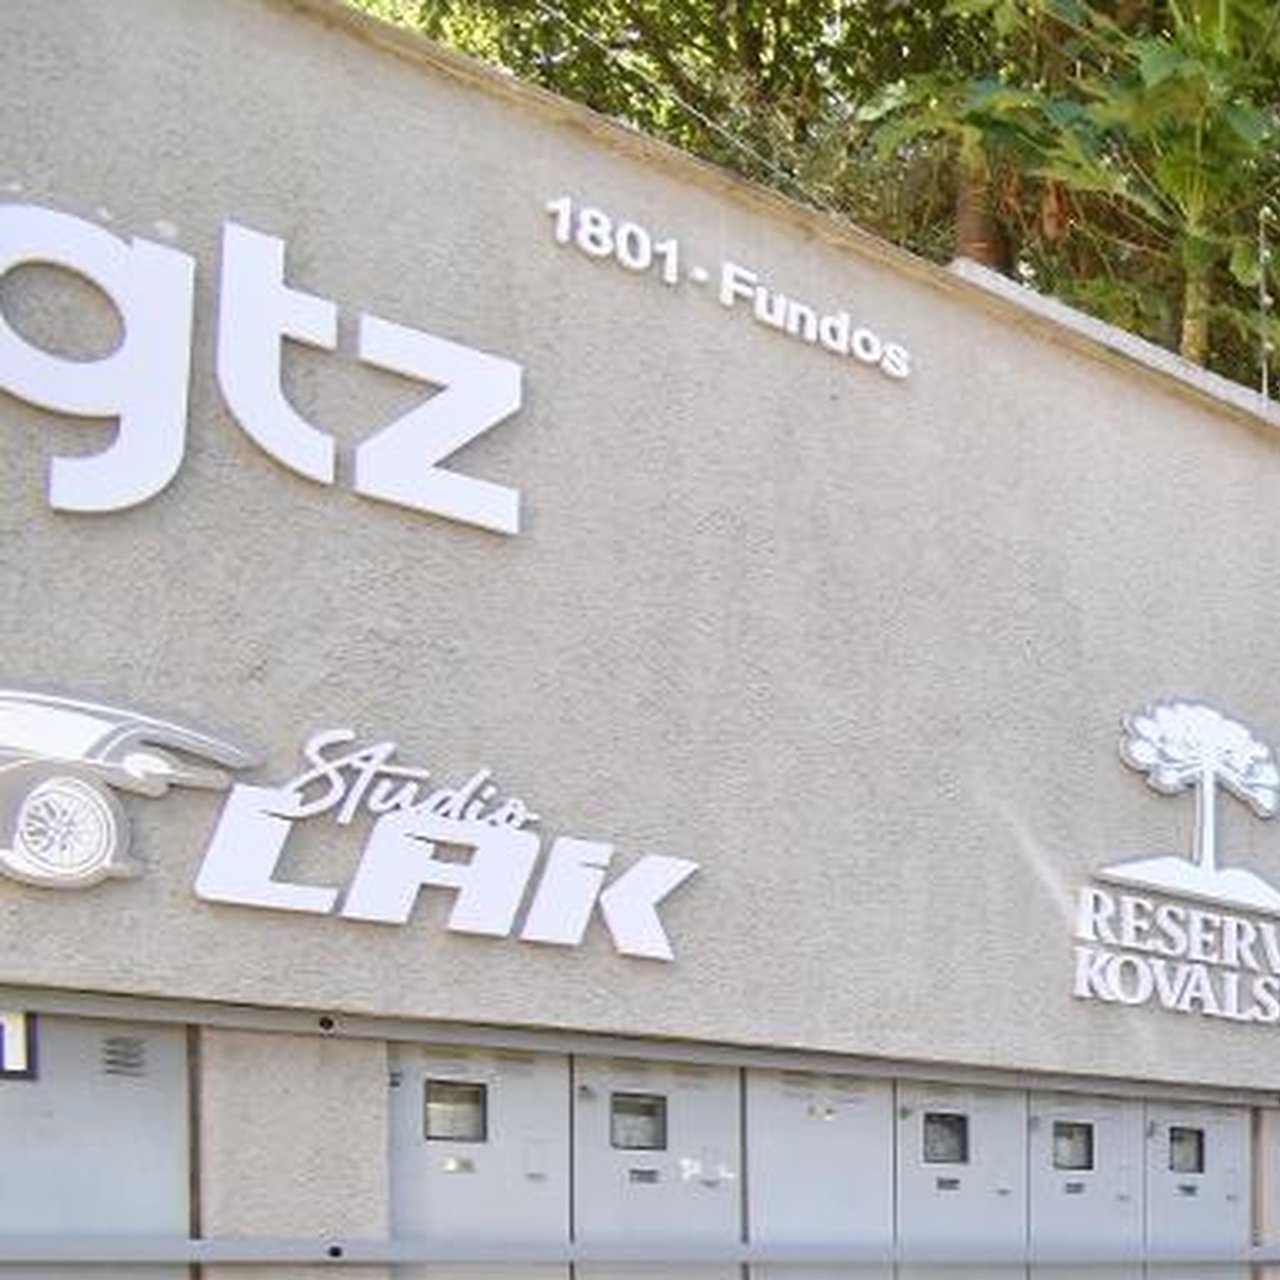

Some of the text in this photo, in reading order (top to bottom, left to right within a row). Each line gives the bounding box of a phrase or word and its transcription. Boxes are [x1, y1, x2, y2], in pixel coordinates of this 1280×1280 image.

[546, 195, 679, 285] 1801
[718, 260, 911, 380] Fundos
[262, 729, 540, 828] Studio
